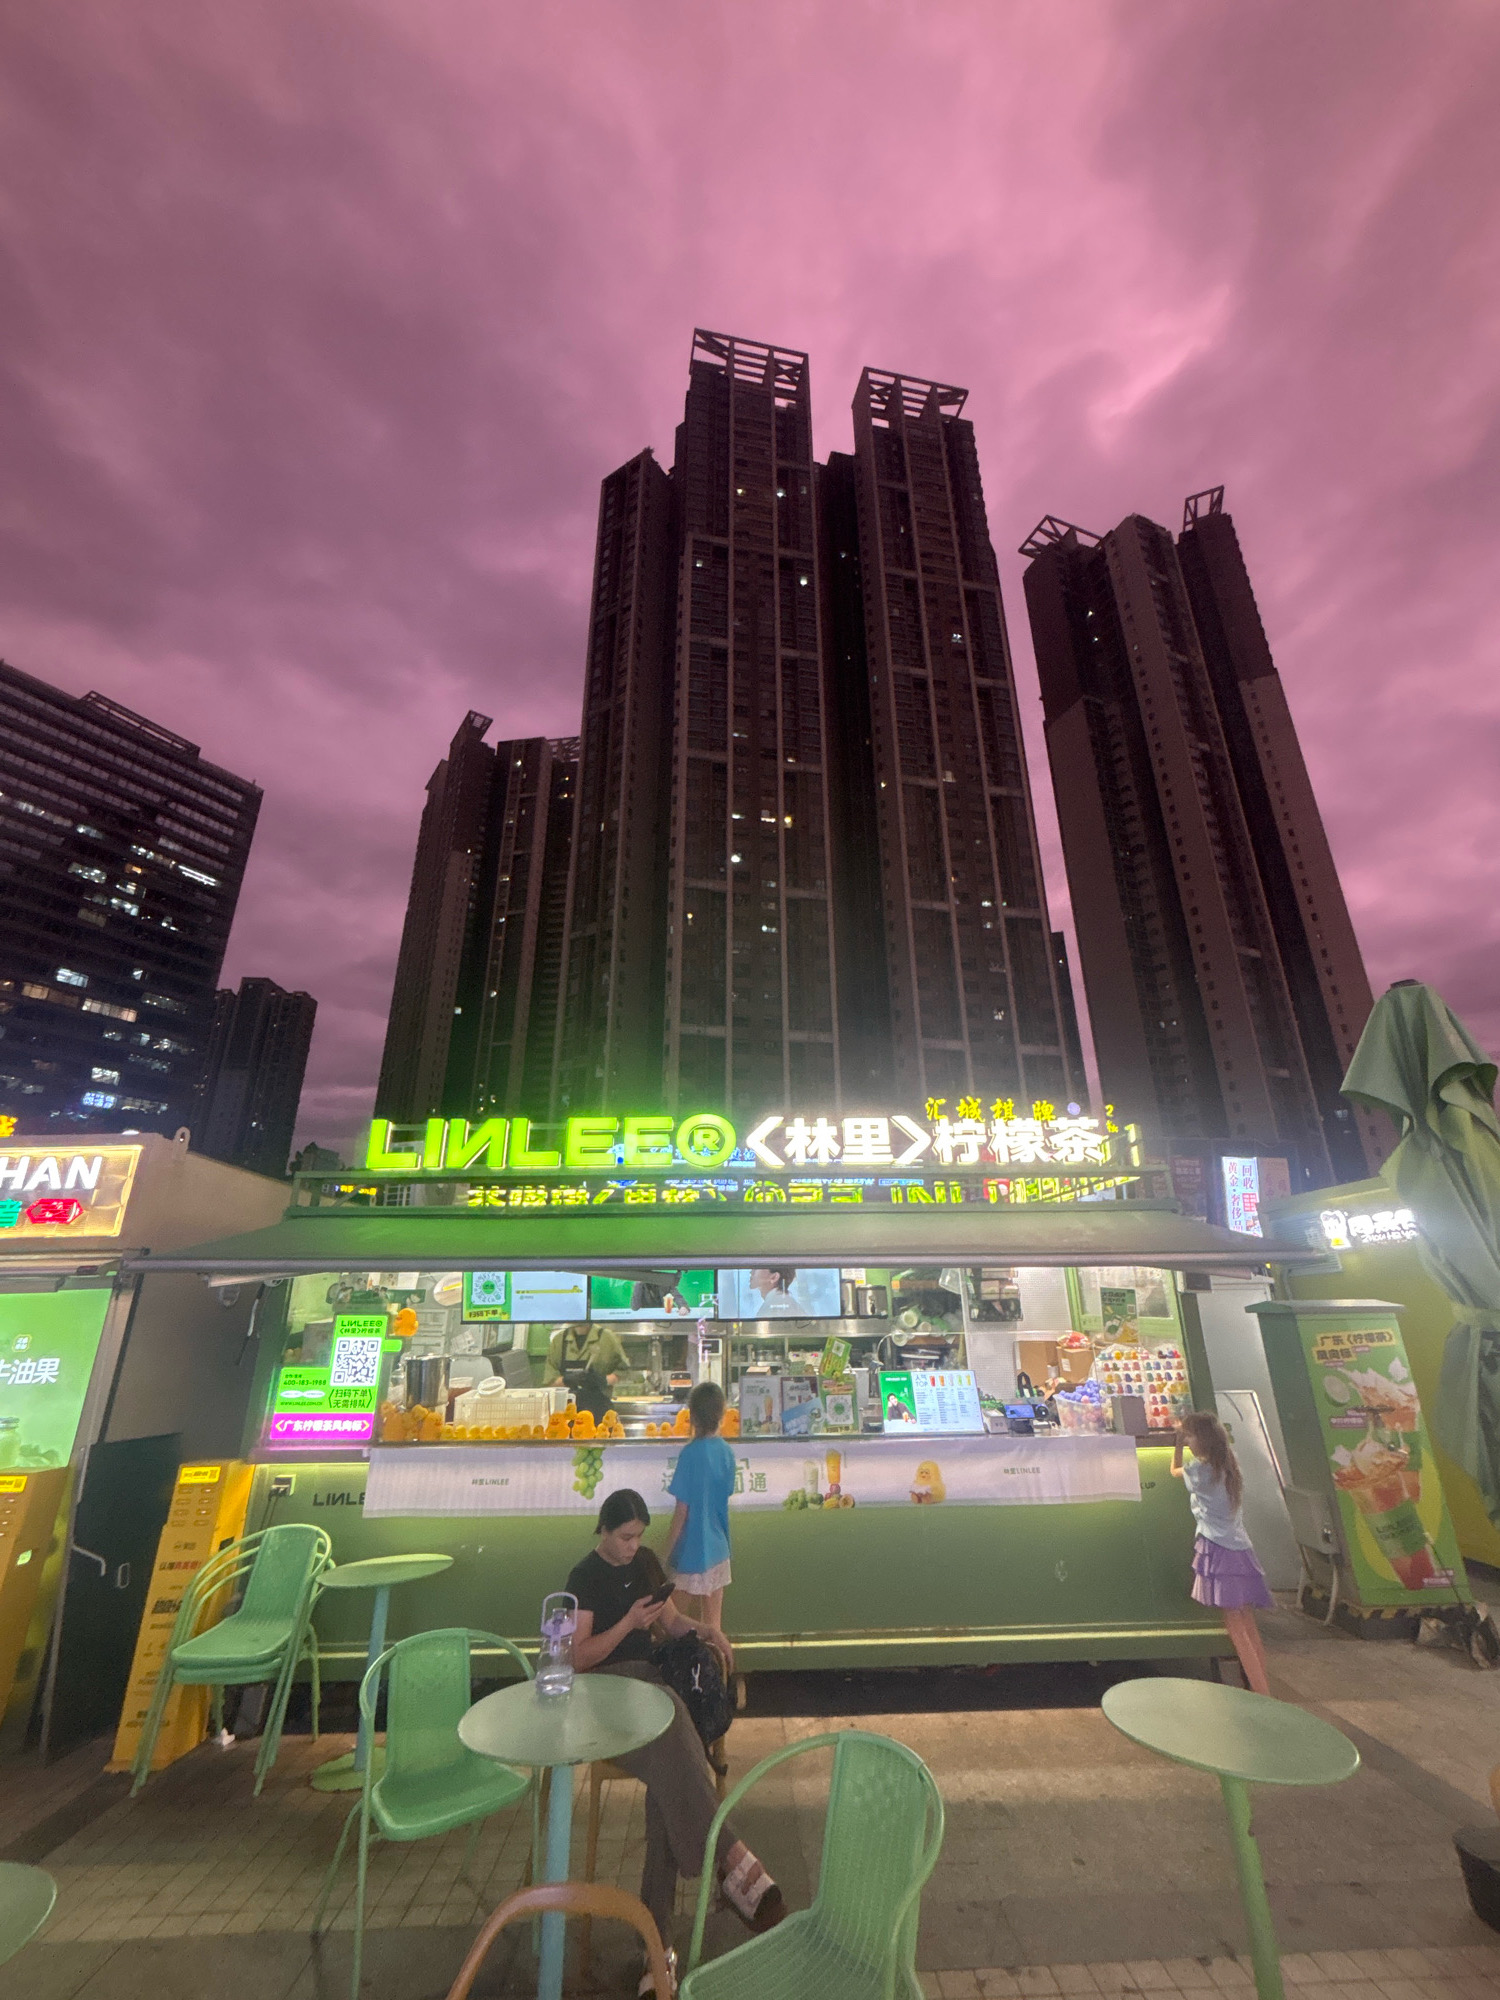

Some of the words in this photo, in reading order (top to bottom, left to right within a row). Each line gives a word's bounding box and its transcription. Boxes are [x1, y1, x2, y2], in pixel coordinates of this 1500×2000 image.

[925, 1096, 1056, 1121] 汇城棋牌
[1242, 1165, 1254, 1189] 回收
[334, 1389, 368, 1398] 扫码下单
[333, 1399, 367, 1408] 无需排队
